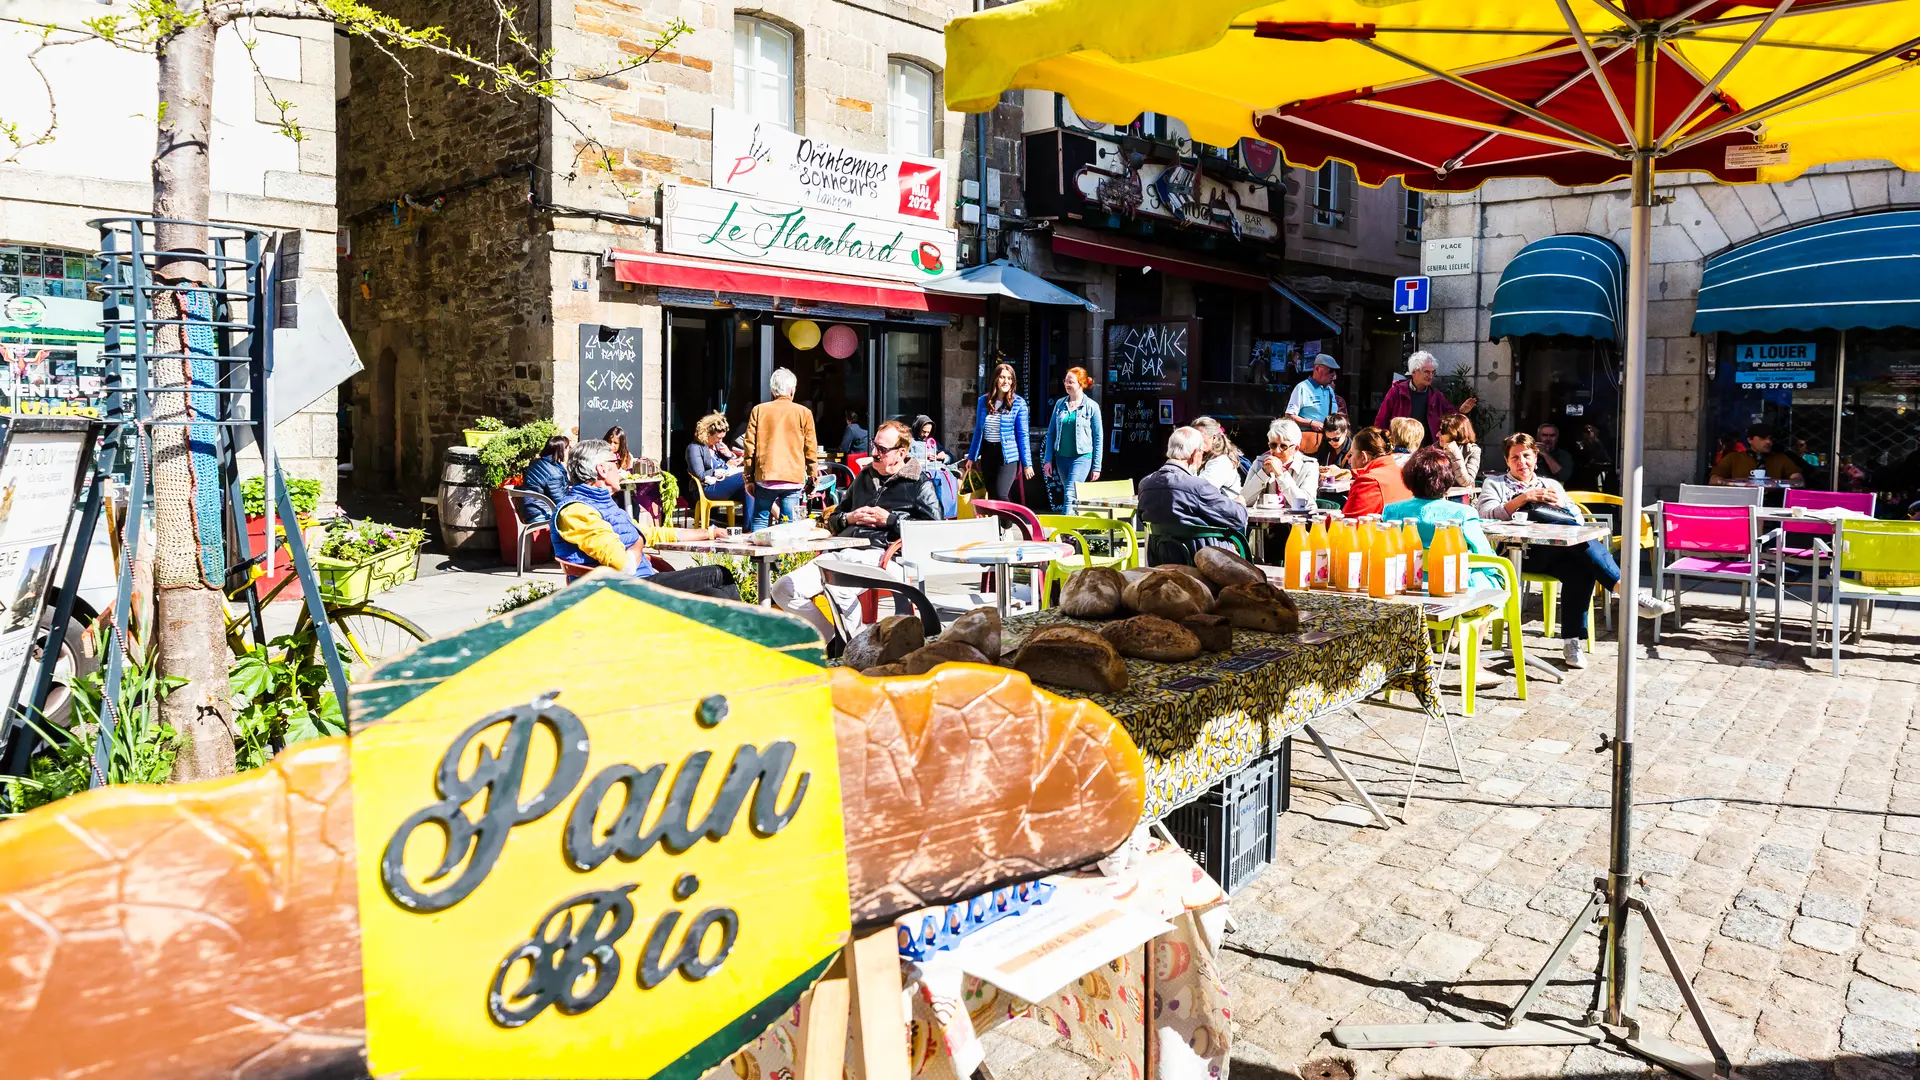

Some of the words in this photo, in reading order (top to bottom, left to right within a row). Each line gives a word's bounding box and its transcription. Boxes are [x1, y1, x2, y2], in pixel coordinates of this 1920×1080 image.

[796, 139, 888, 183] Printemps
[799, 166, 878, 198] sonneurs
[907, 195, 932, 211] 2022
[1244, 214, 1263, 227] BAR
[698, 202, 768, 257] Le
[750, 204, 904, 263] Flambard
[1427, 264, 1448, 272] GENERAL
[585, 335, 600, 348] LA
[1744, 346, 1754, 359] A
[1760, 345, 1807, 359] LOUER
[1141, 357, 1166, 379] BAR
[0, 384, 80, 398] VENTES
[586, 370, 635, 392] EXPOS
[380, 690, 811, 915] Pain
[487, 873, 740, 1030] Bio
